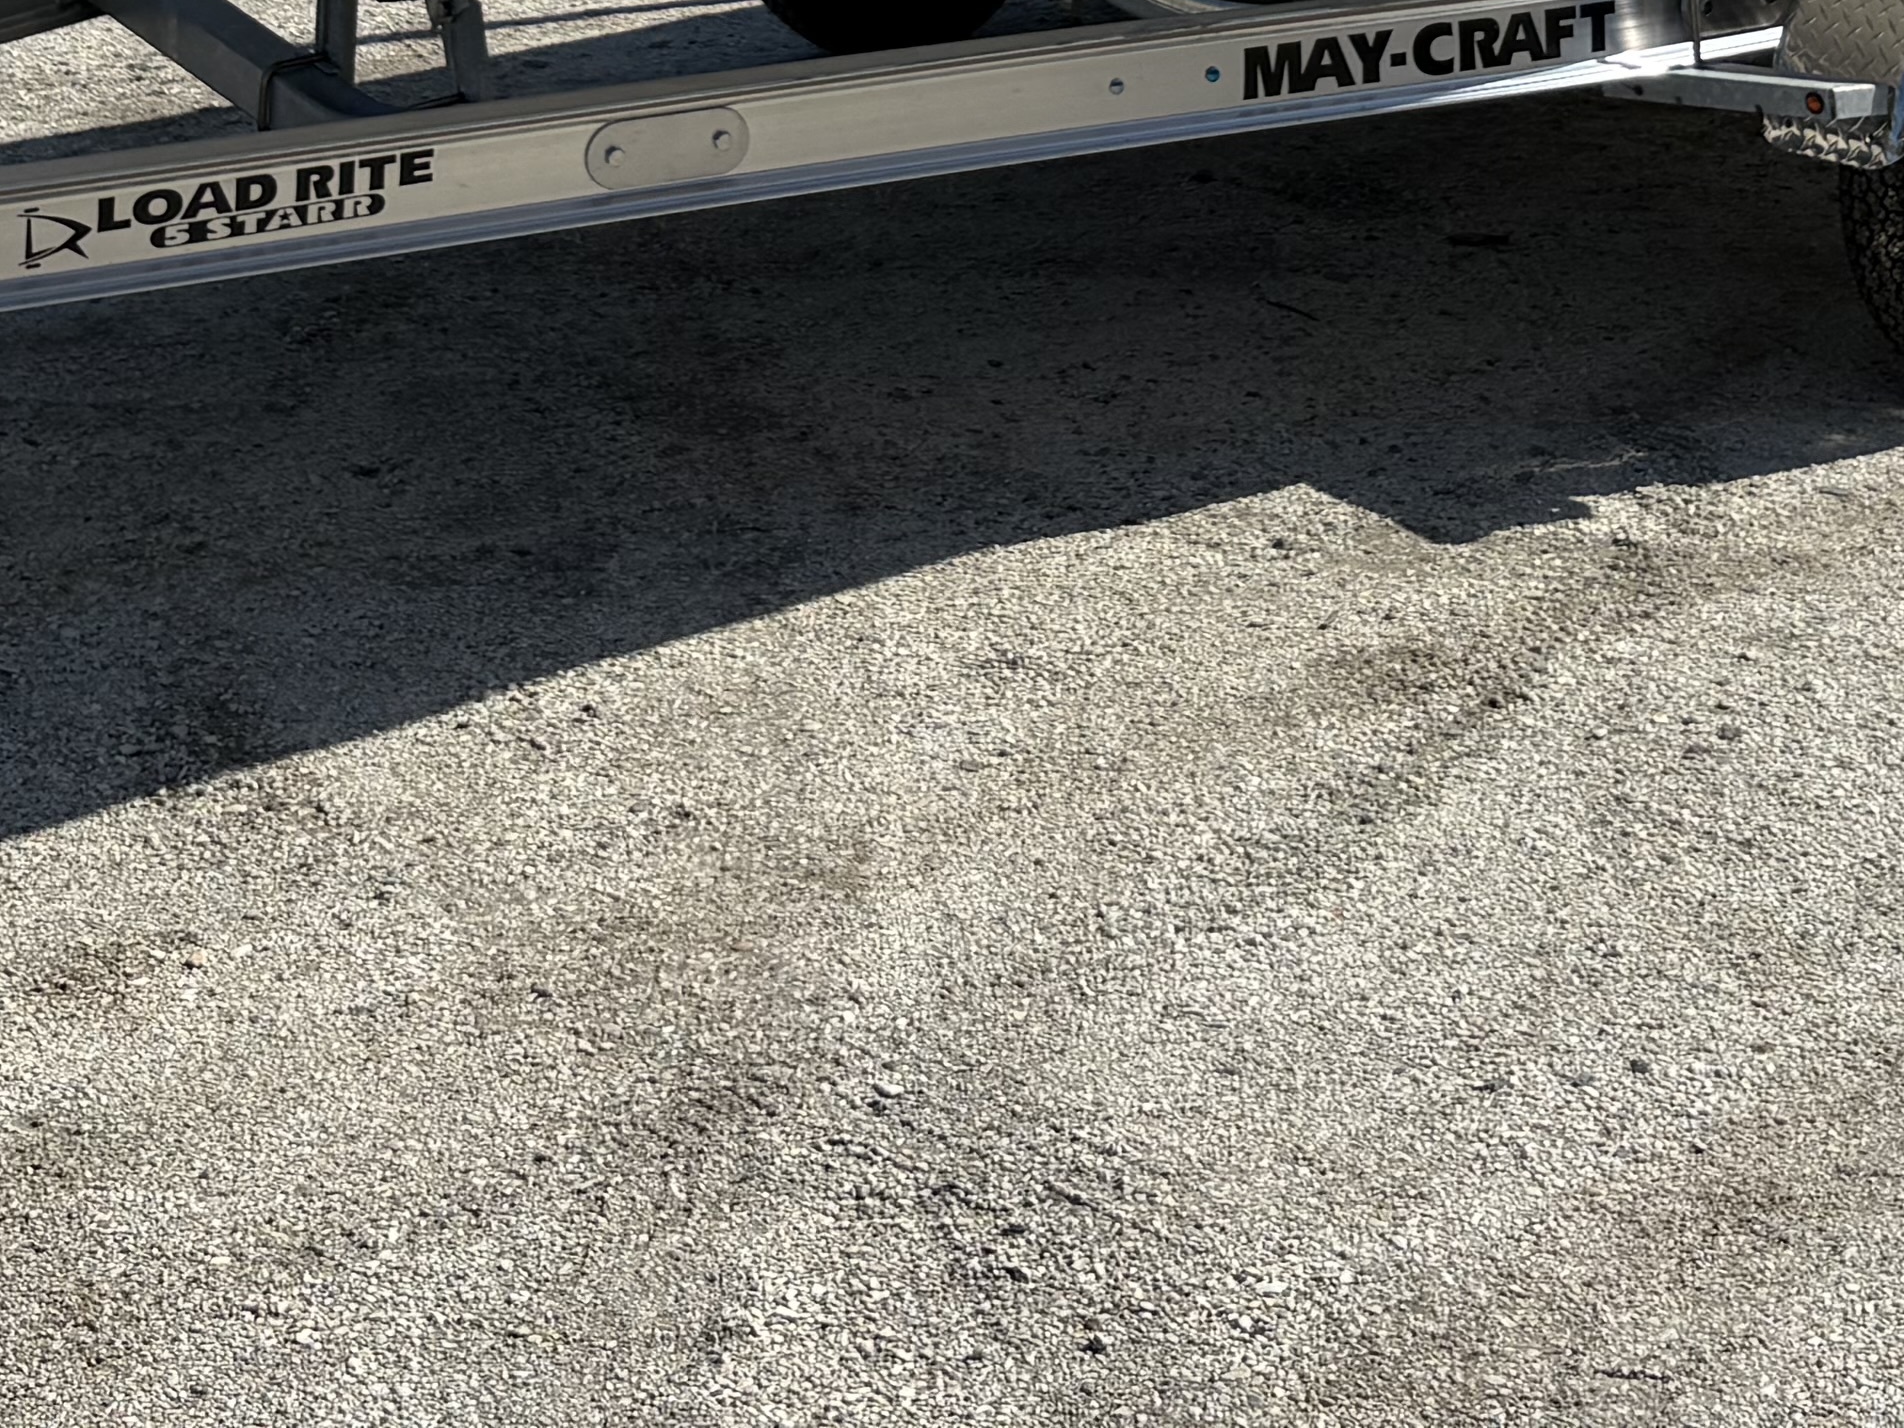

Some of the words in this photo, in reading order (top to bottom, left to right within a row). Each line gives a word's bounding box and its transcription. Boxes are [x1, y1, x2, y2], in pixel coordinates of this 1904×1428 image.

[1242, 0, 1616, 101] MAY-CRAFT
[97, 173, 278, 233] LOAD
[295, 148, 435, 202] RITE
[162, 223, 191, 247] 5
[205, 194, 377, 241] STARR
